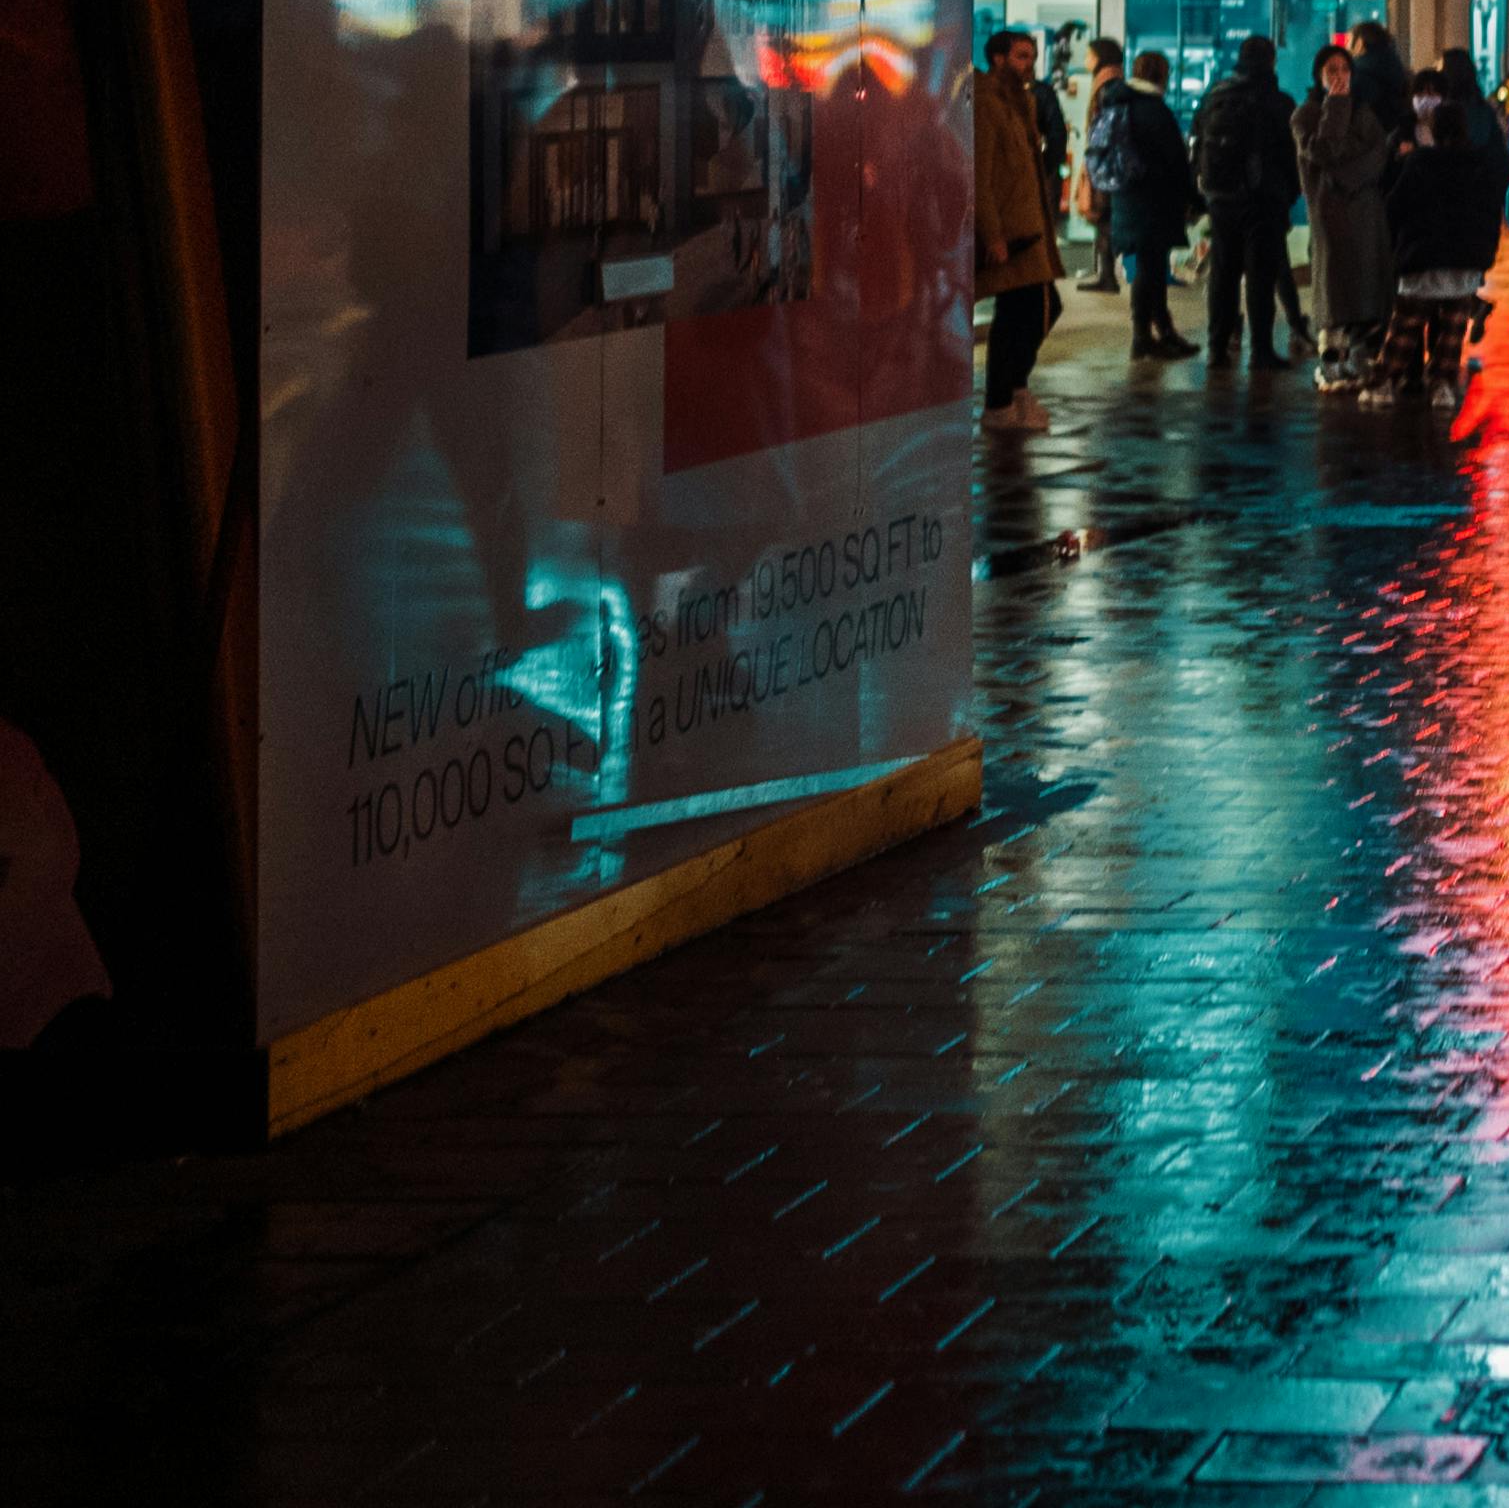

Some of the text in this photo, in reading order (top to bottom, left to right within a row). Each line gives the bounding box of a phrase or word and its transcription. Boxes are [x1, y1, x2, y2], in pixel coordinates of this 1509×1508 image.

[347, 748, 493, 868] 110,000
[649, 696, 666, 745] a
[675, 632, 794, 734] UNIQUE
[797, 584, 927, 687] LOCATION
[348, 664, 450, 770] NEW
[676, 584, 740, 650] from
[747, 540, 837, 622] 19,500
[842, 526, 881, 590] SQ
[886, 514, 917, 576] FT
[922, 515, 943, 564] to
